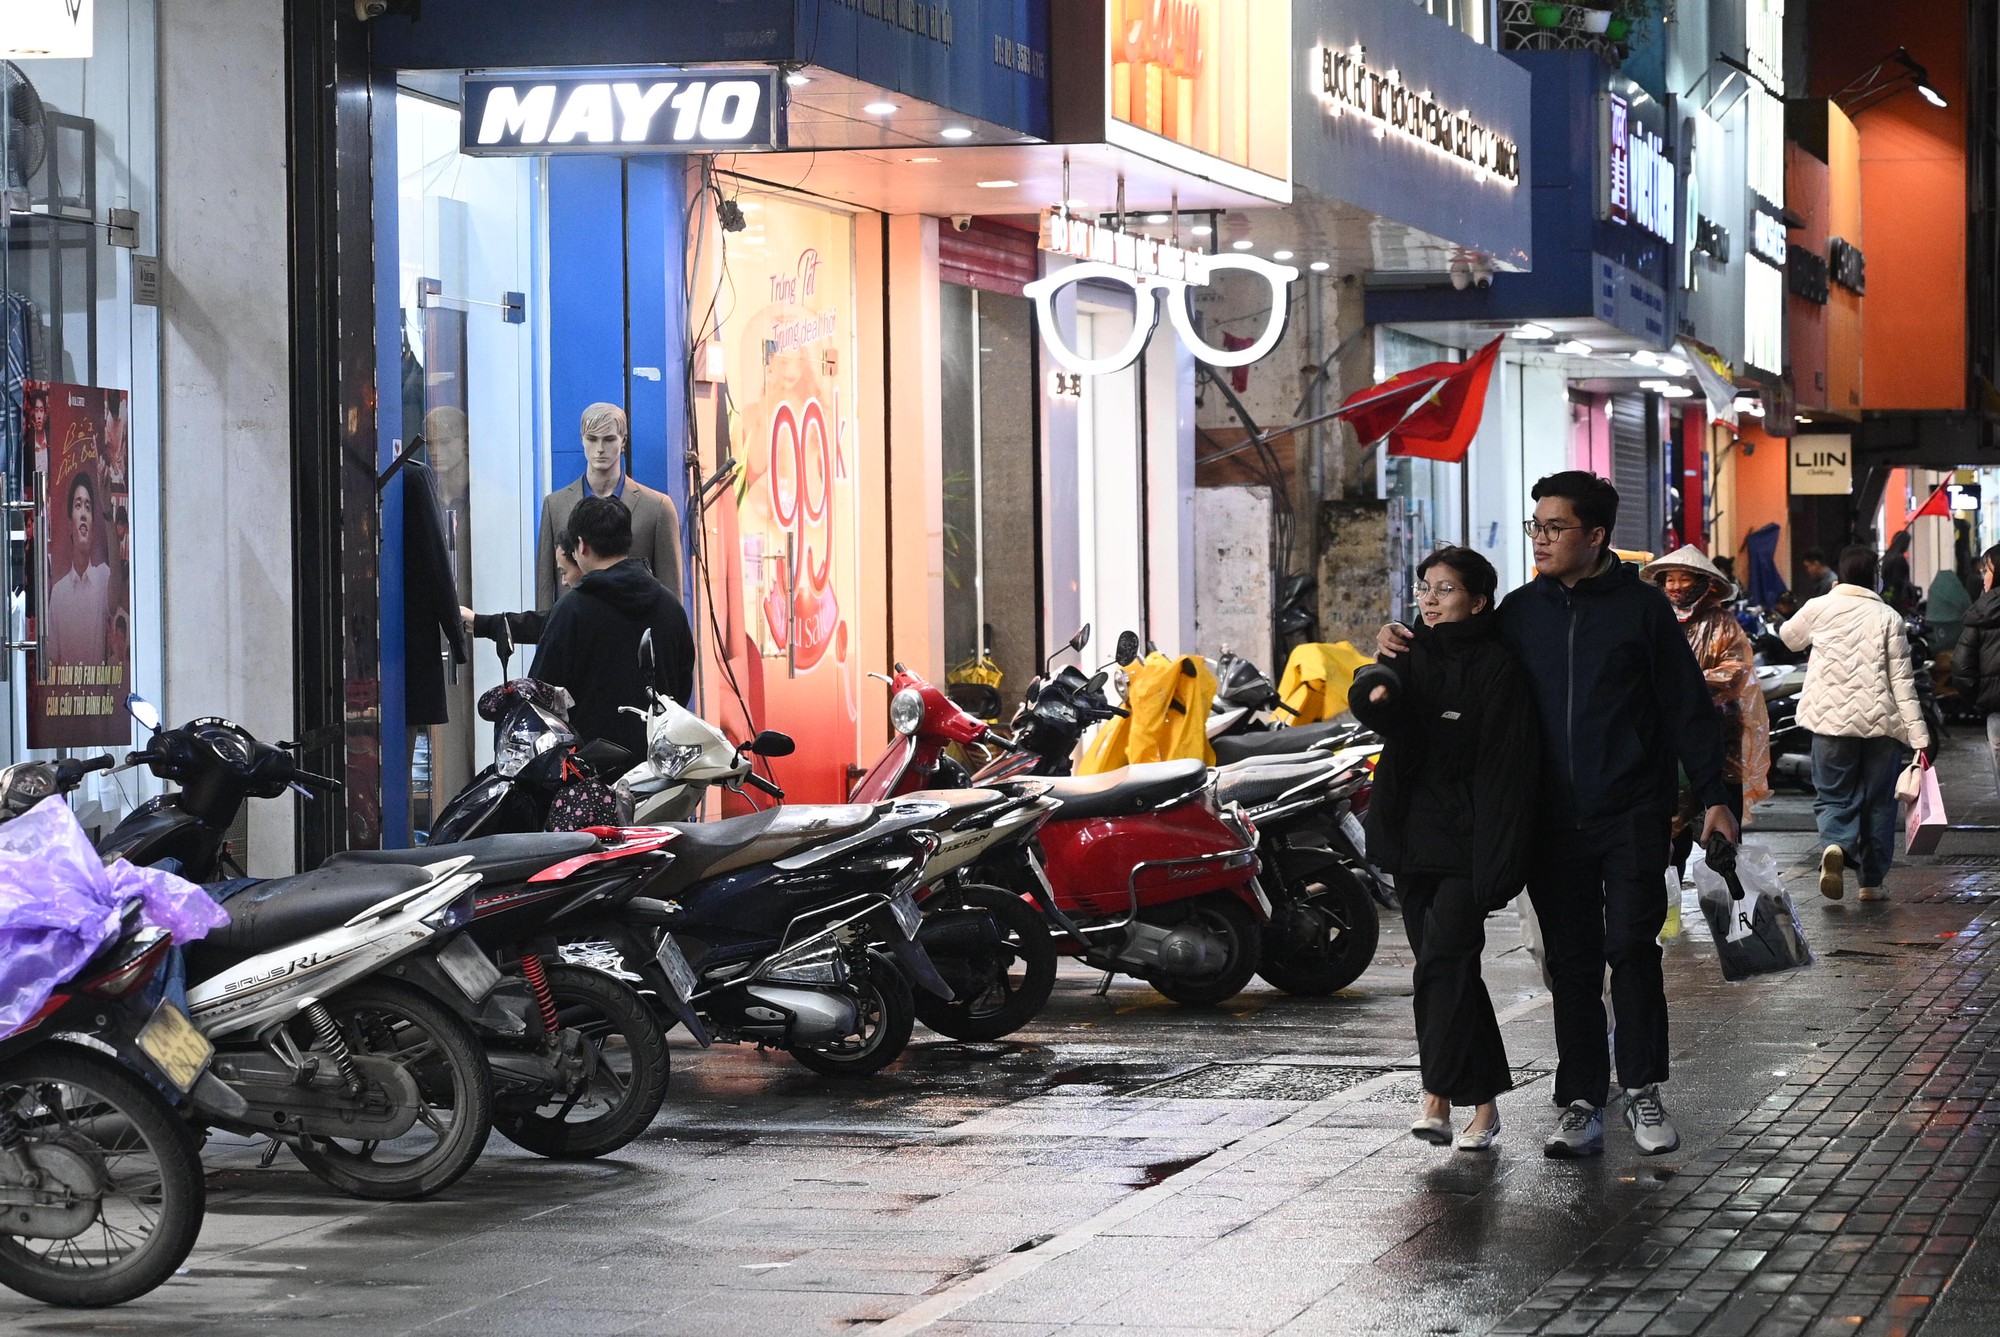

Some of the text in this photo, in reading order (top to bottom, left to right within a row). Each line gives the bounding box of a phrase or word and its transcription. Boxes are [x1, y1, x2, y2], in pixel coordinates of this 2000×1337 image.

[477, 81, 761, 144] MAY10
[1796, 452, 1846, 467] LIIN
[57, 662, 73, 685] TOÀN
[74, 662, 83, 689] BỘ
[83, 666, 96, 685] FAN
[46, 690, 59, 716] CỦA
[73, 690, 85, 715] THỦ
[224, 966, 286, 993] SIRIUS
